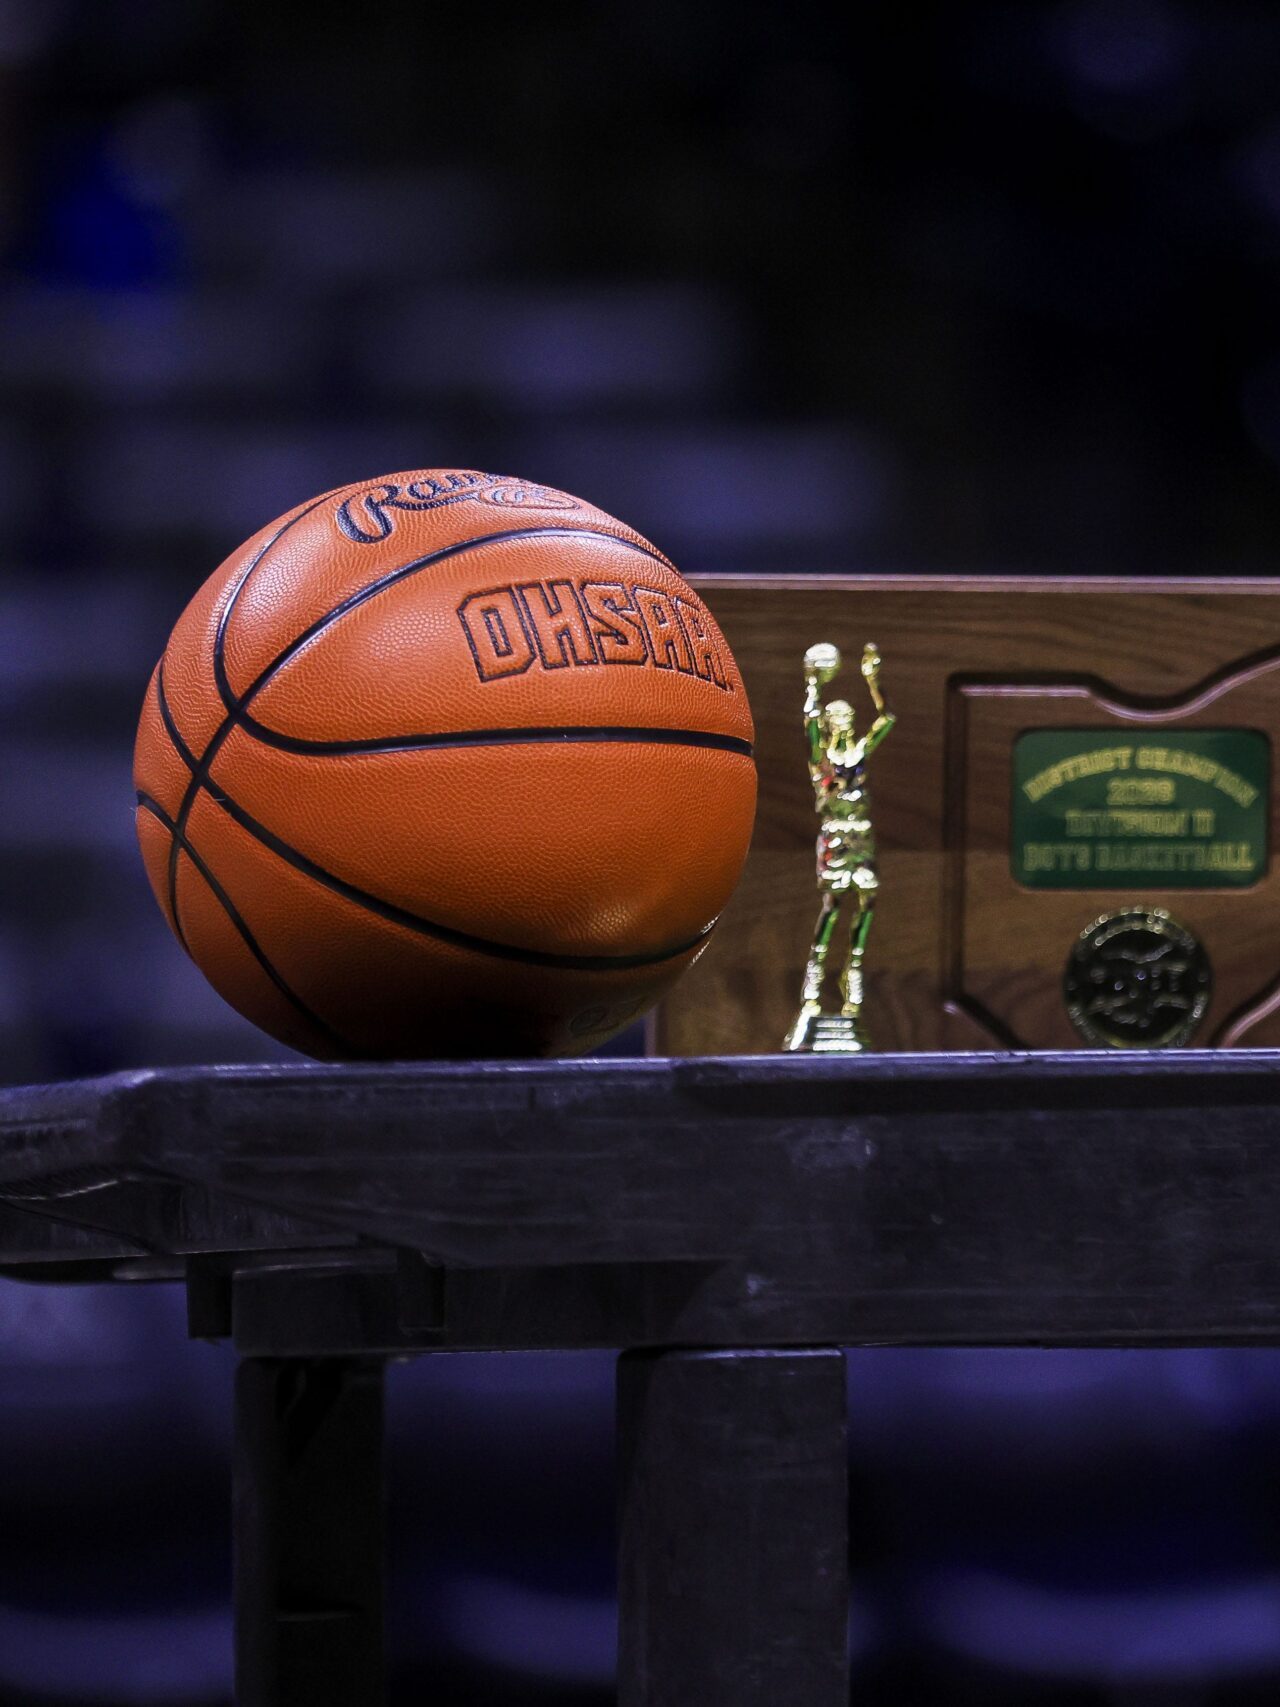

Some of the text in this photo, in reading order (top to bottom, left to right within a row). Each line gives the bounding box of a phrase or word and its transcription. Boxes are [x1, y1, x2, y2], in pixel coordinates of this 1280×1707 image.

[456, 579, 735, 694] OHSAA
[1022, 746, 1260, 808] DISTRICT CHAMPION
[1065, 808, 1189, 837] DIVISION
[1023, 843, 1255, 871] BOYS BASKETBALL
